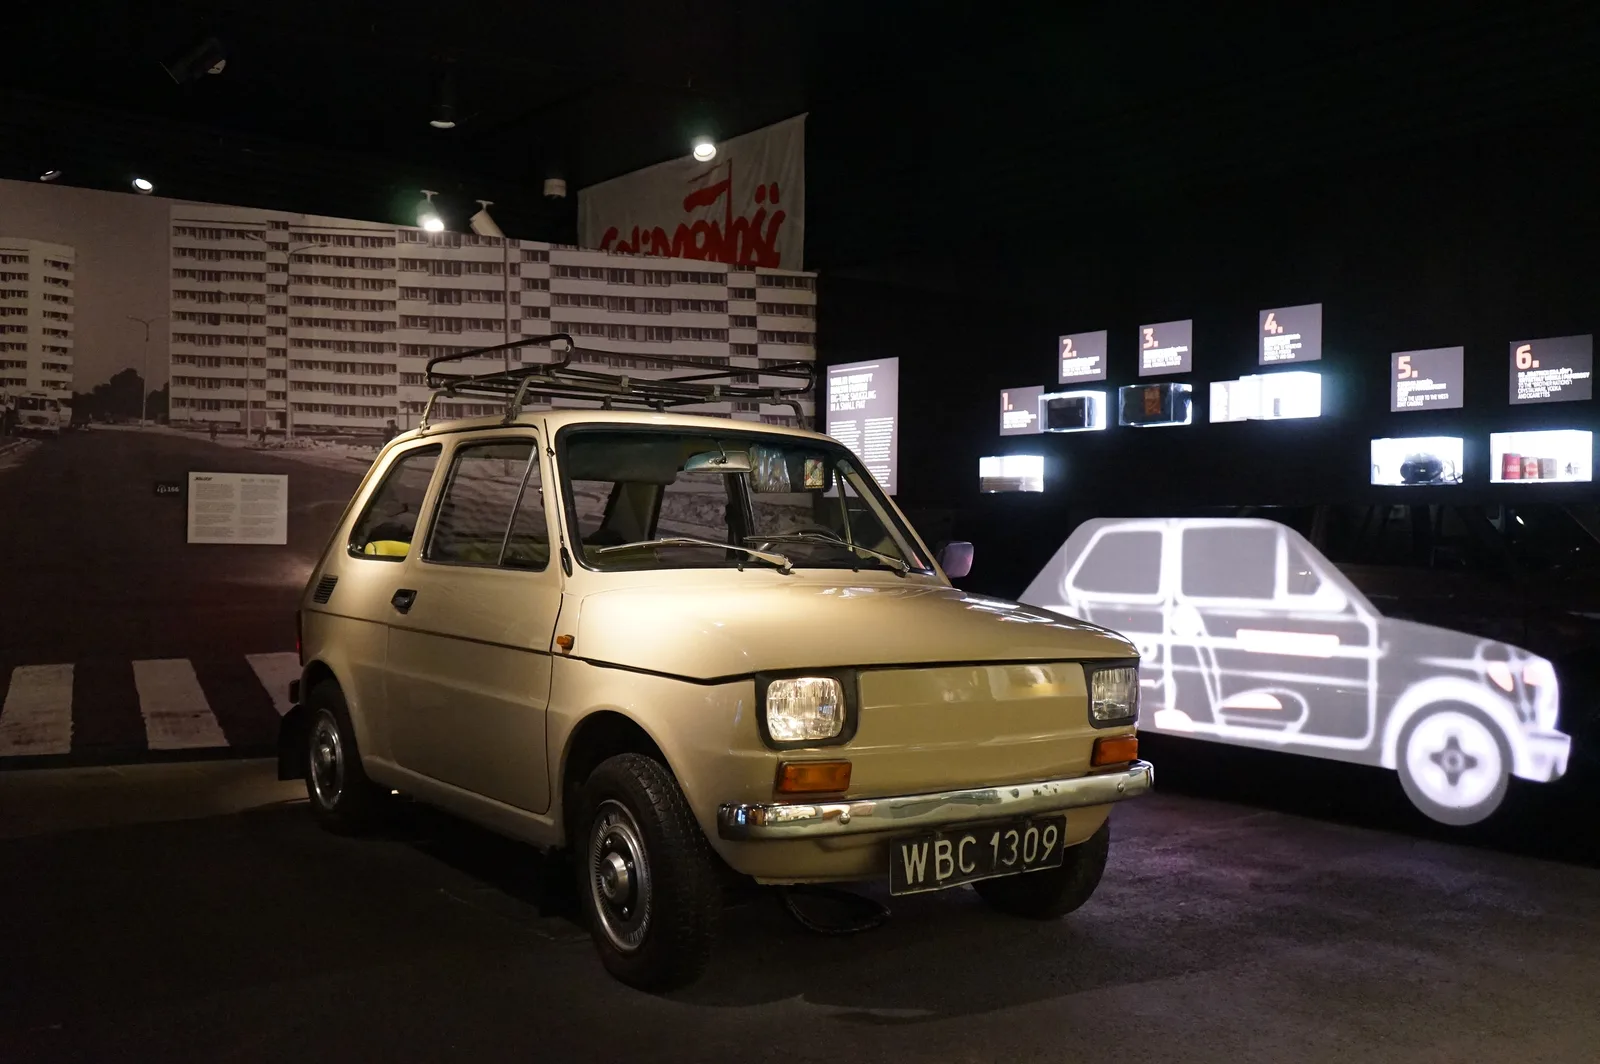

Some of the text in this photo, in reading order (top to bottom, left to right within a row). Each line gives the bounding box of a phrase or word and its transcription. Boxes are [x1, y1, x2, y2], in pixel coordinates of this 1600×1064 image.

[1264, 313, 1283, 334] 4.
[1062, 338, 1077, 358] 2.
[1143, 328, 1158, 348] 3.
[1516, 344, 1539, 369] 6.
[1398, 356, 1418, 379] 5.
[1002, 392, 1013, 410] 1.
[901, 825, 1058, 885] WBC 1309
